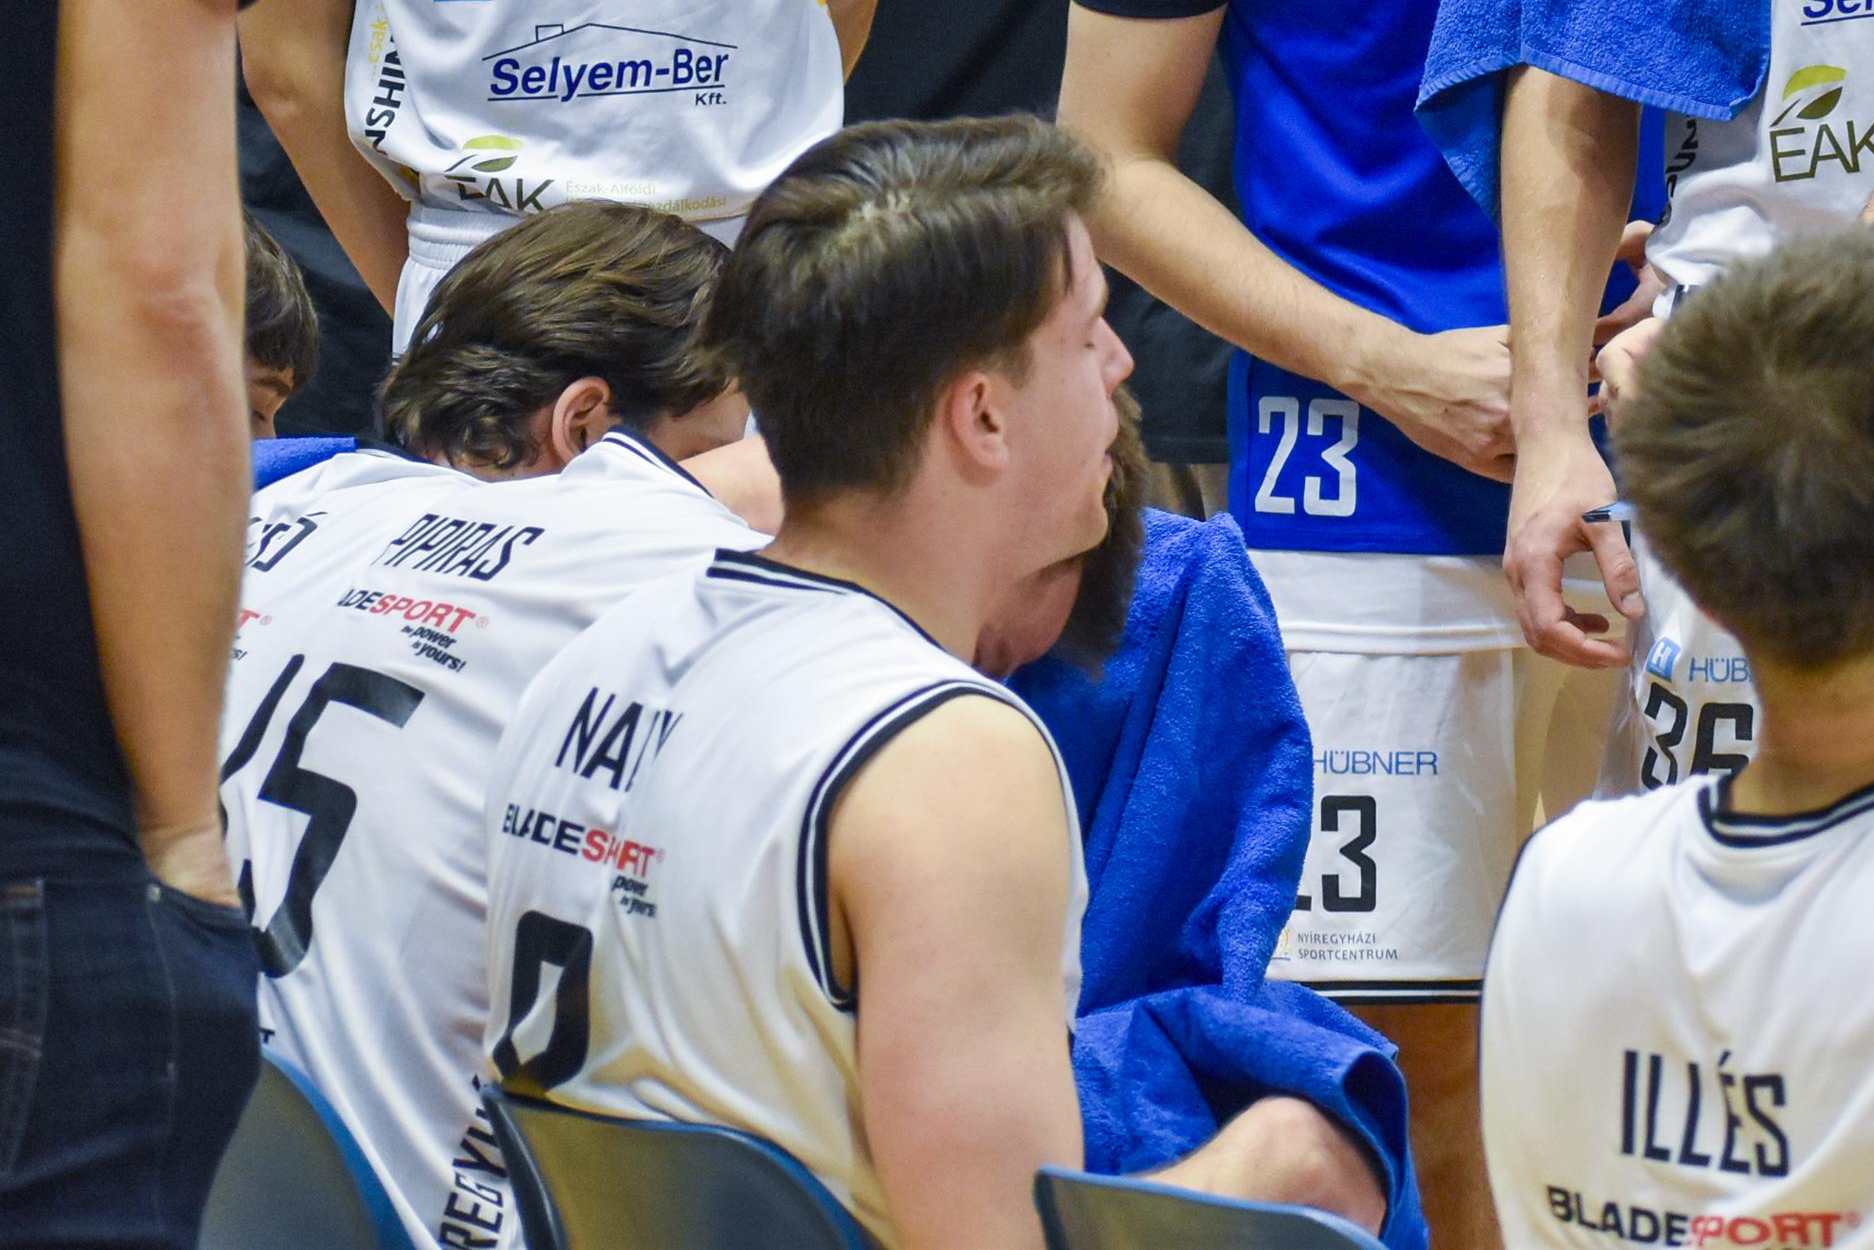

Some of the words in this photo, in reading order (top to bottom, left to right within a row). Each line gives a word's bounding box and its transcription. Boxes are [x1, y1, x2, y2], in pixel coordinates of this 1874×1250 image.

[489, 48, 730, 103] Selyem-Ber
[695, 91, 728, 106] Kft.
[1254, 395, 1360, 518] 23
[369, 513, 546, 582] PIPIRAS
[409, 626, 457, 649] power
[415, 643, 467, 672] yours!
[1688, 657, 1752, 683] HÜB
[1640, 681, 1755, 790] 36
[1313, 750, 1439, 776] HÜBNER
[1295, 794, 1378, 913] 3
[1297, 930, 1376, 945] NYÍREGYHÁZI
[1298, 947, 1399, 961] SPORTCENTRUM
[1619, 1049, 1790, 1179] ILLÉS
